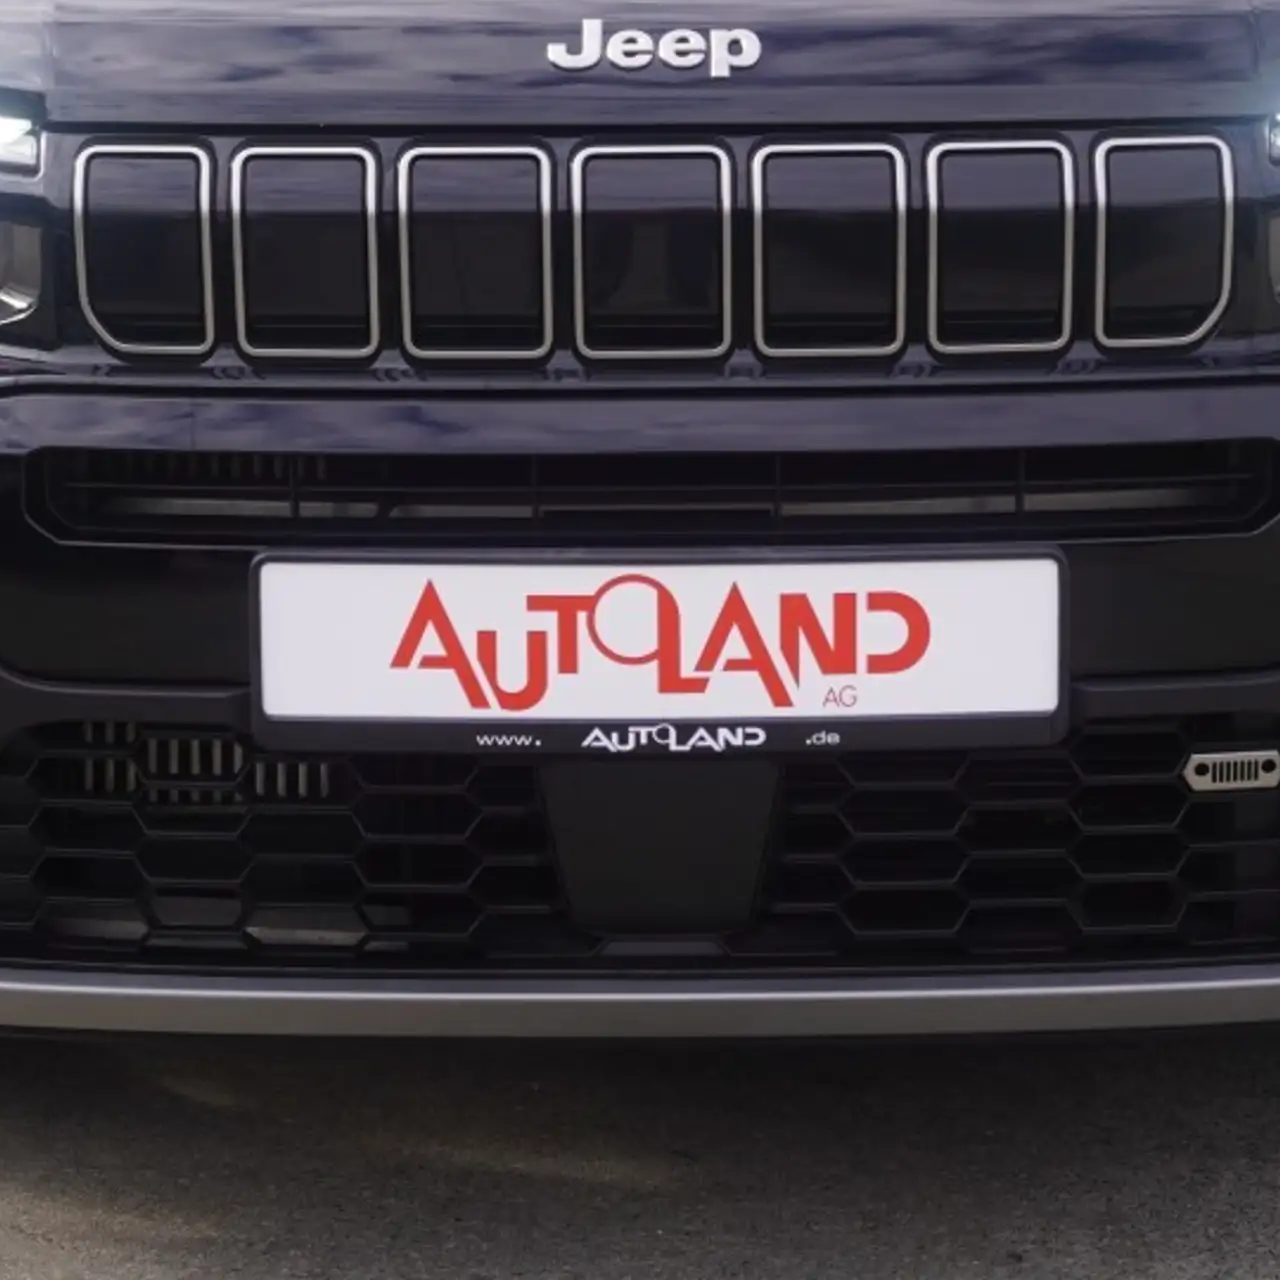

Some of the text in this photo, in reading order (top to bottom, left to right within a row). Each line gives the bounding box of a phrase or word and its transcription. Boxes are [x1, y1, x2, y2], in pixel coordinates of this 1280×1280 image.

[546, 18, 762, 78] Jeep
[390, 573, 931, 712] AUTOLAND
[822, 684, 858, 709] AG
[475, 723, 841, 753] www. AUTOLAND .de
